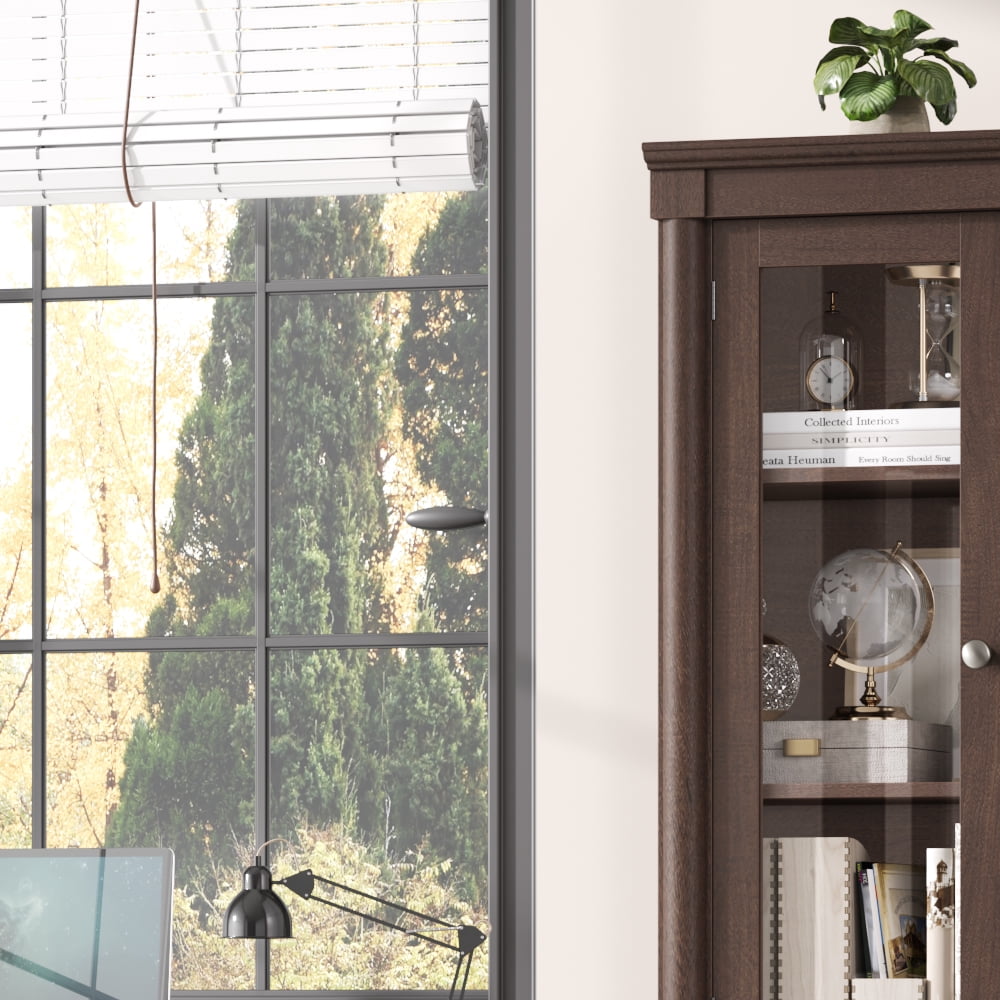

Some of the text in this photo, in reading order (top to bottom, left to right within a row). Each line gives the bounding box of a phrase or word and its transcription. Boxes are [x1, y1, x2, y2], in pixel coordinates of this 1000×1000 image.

[804, 416, 900, 427] Collected Interiors
[811, 436, 888, 444] SIMPLICITY
[788, 455, 836, 465] Heuman
[882, 455, 904, 463] Room
